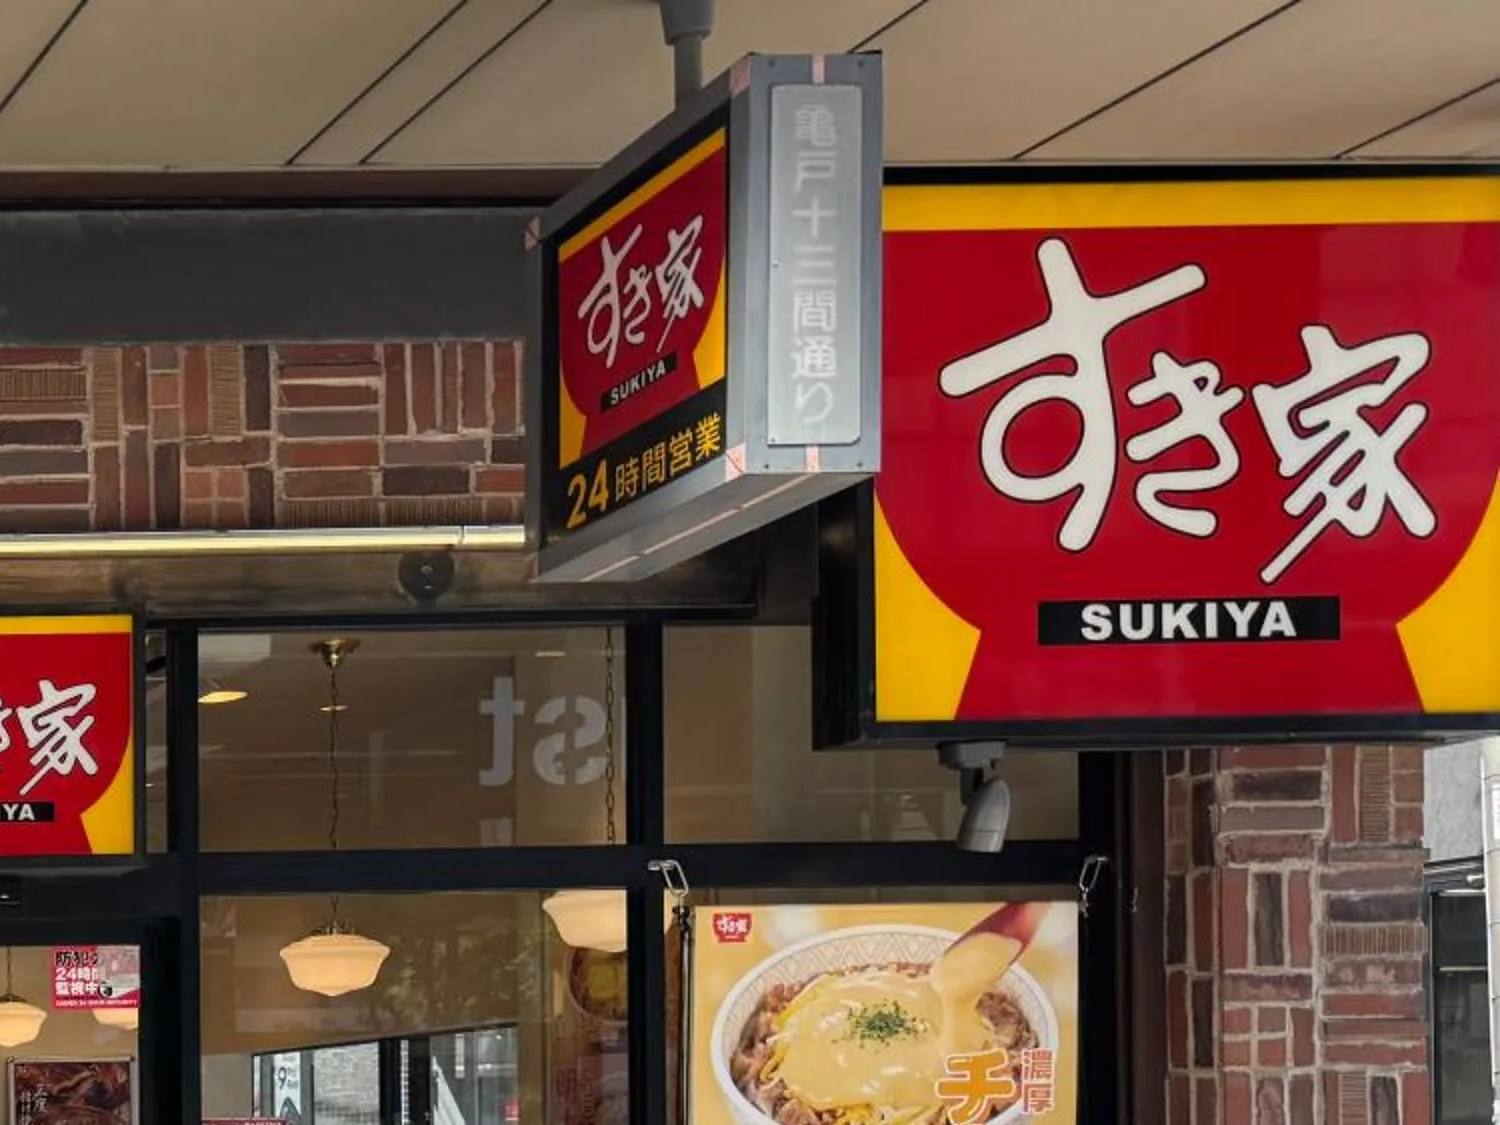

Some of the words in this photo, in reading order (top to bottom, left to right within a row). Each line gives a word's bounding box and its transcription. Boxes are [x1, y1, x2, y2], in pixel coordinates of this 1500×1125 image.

[578, 215, 704, 368] すき家
[792, 105, 838, 426] 亀戸十三間通り
[610, 360, 667, 404] SUKIYA
[939, 236, 1437, 584] すき家
[566, 413, 722, 529] 24時間営業
[1080, 600, 1297, 641] SUKIYA
[1023, 1048, 1054, 1114] 濃厚
